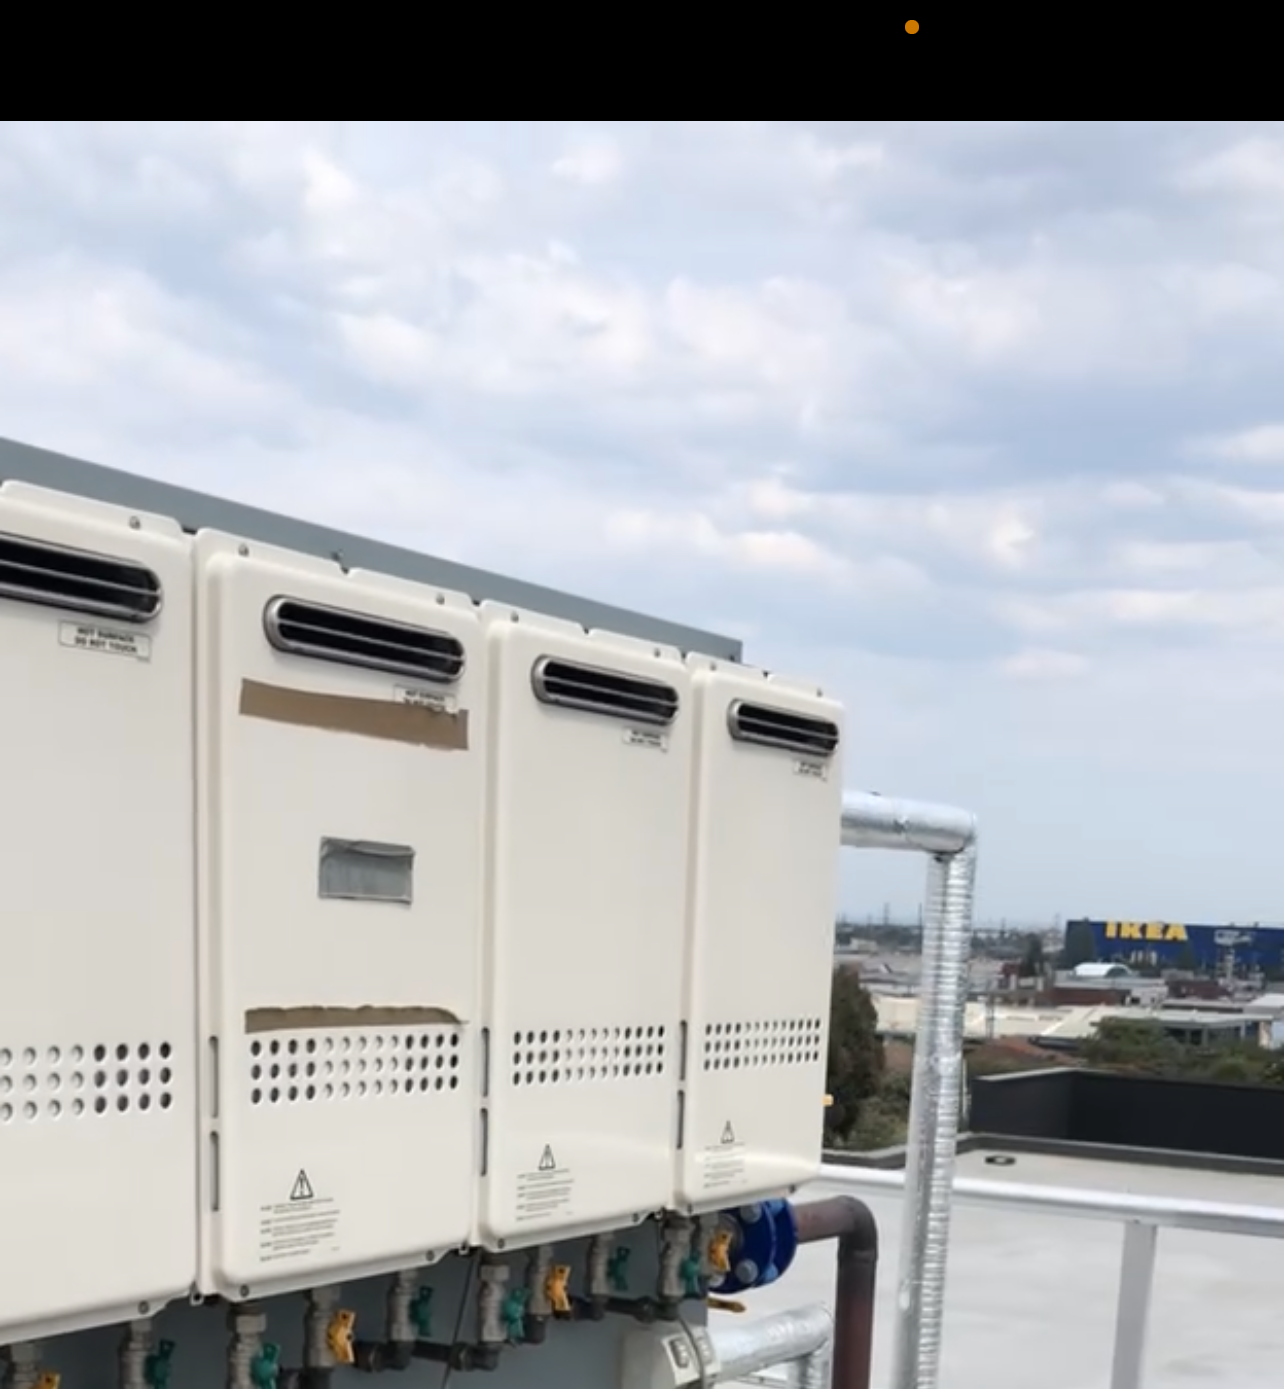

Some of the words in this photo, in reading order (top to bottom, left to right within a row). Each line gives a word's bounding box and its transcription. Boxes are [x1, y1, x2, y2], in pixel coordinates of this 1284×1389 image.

[75, 636, 87, 645] DO
[89, 638, 106, 648] NOT
[109, 641, 137, 653] TOUCH
[1104, 920, 1189, 941] IKEA
